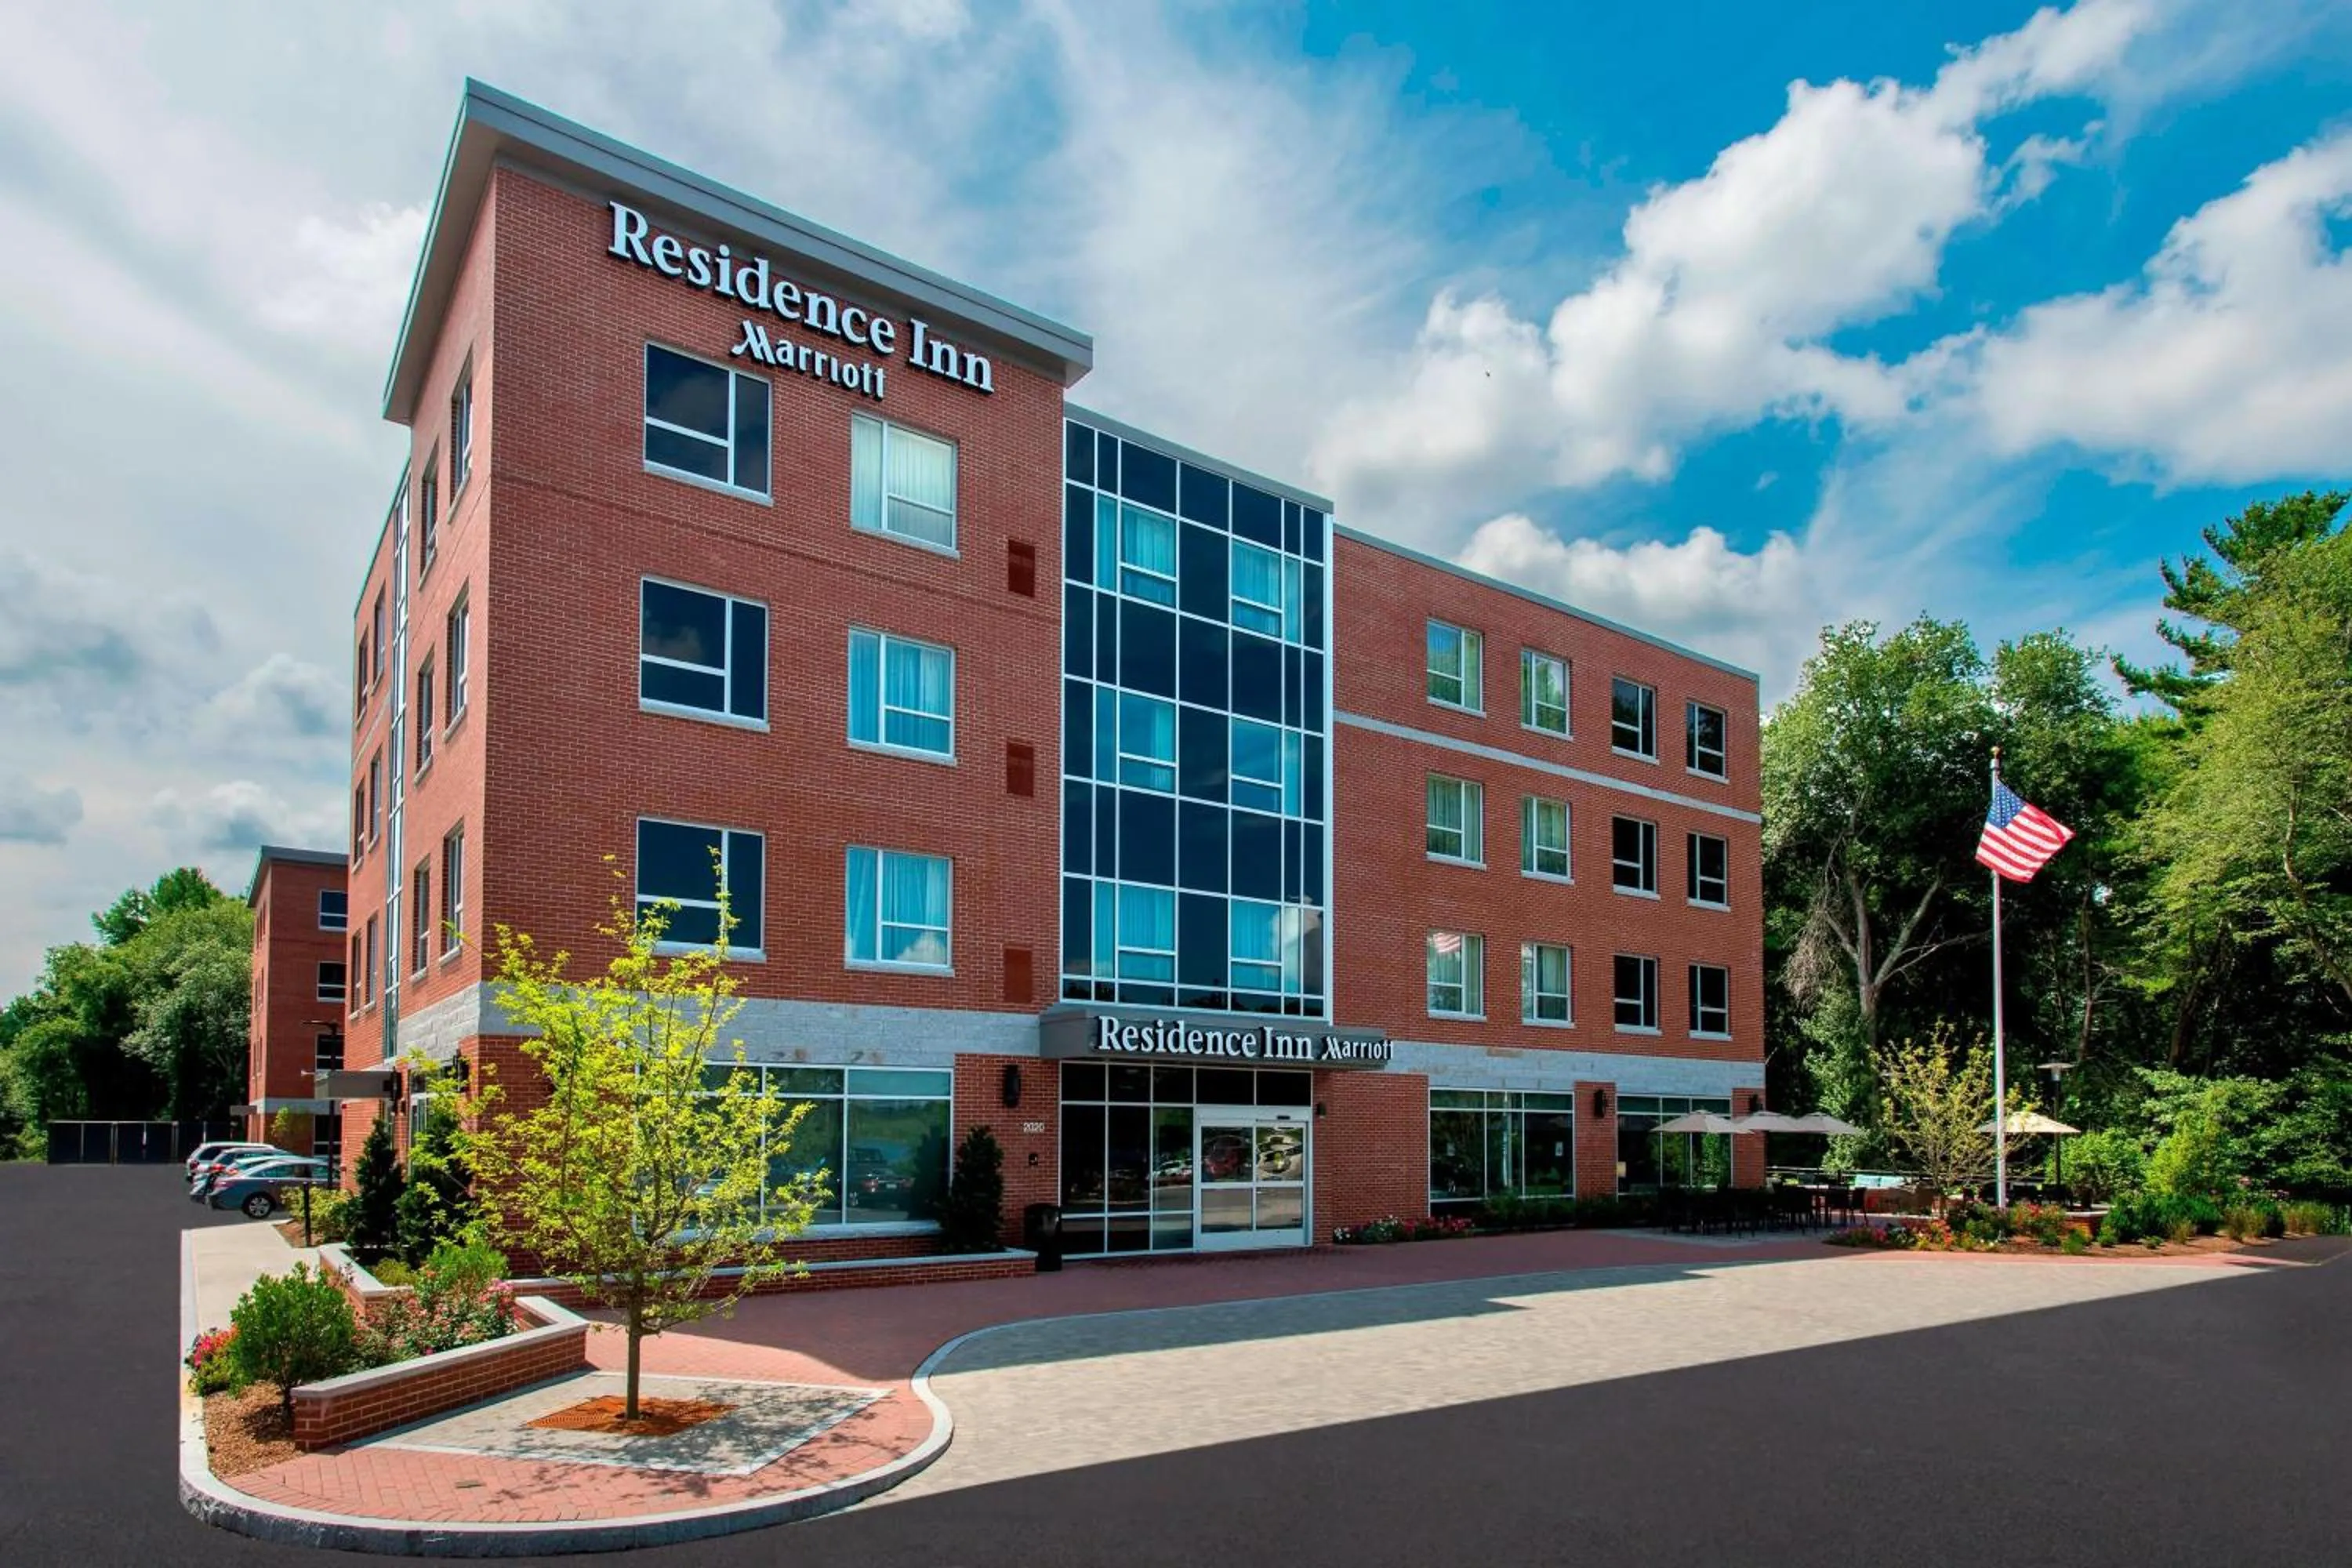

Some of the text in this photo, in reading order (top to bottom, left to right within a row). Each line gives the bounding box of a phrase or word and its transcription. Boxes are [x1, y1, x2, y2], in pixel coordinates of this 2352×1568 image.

[608, 200, 995, 393] Residence Inn
[730, 319, 887, 399] Marriott
[1098, 1015, 1394, 1061] Residence Inn Marriott
